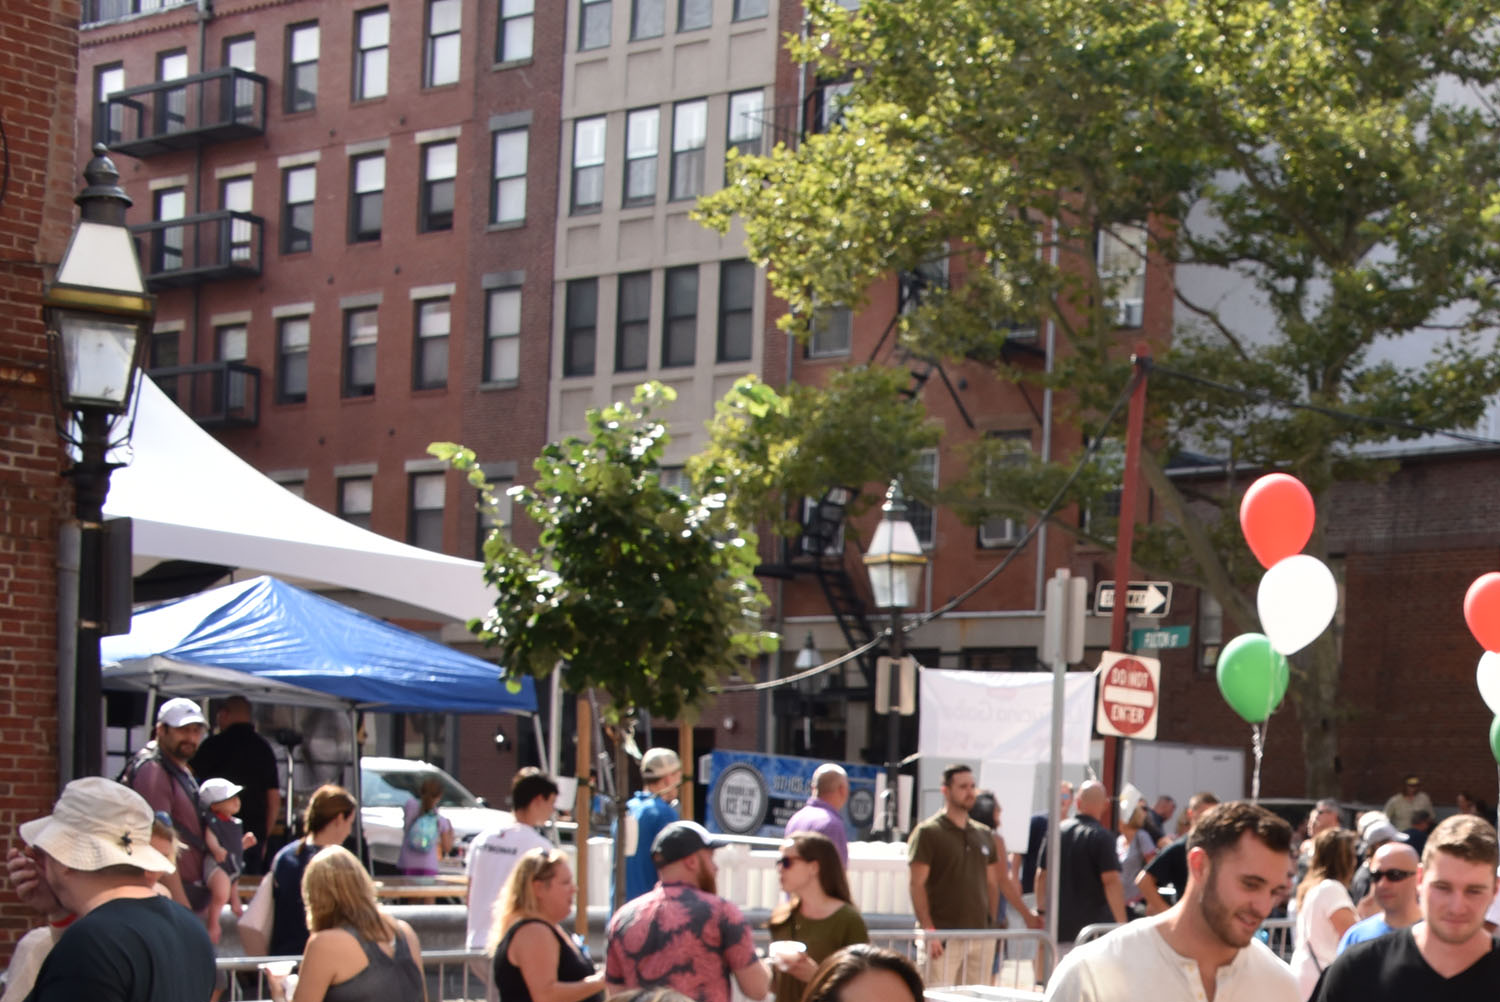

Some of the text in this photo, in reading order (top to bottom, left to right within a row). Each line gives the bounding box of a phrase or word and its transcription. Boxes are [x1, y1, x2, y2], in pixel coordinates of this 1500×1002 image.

[1111, 667, 1148, 688] DO NOT
[1111, 704, 1145, 724] ENTER
